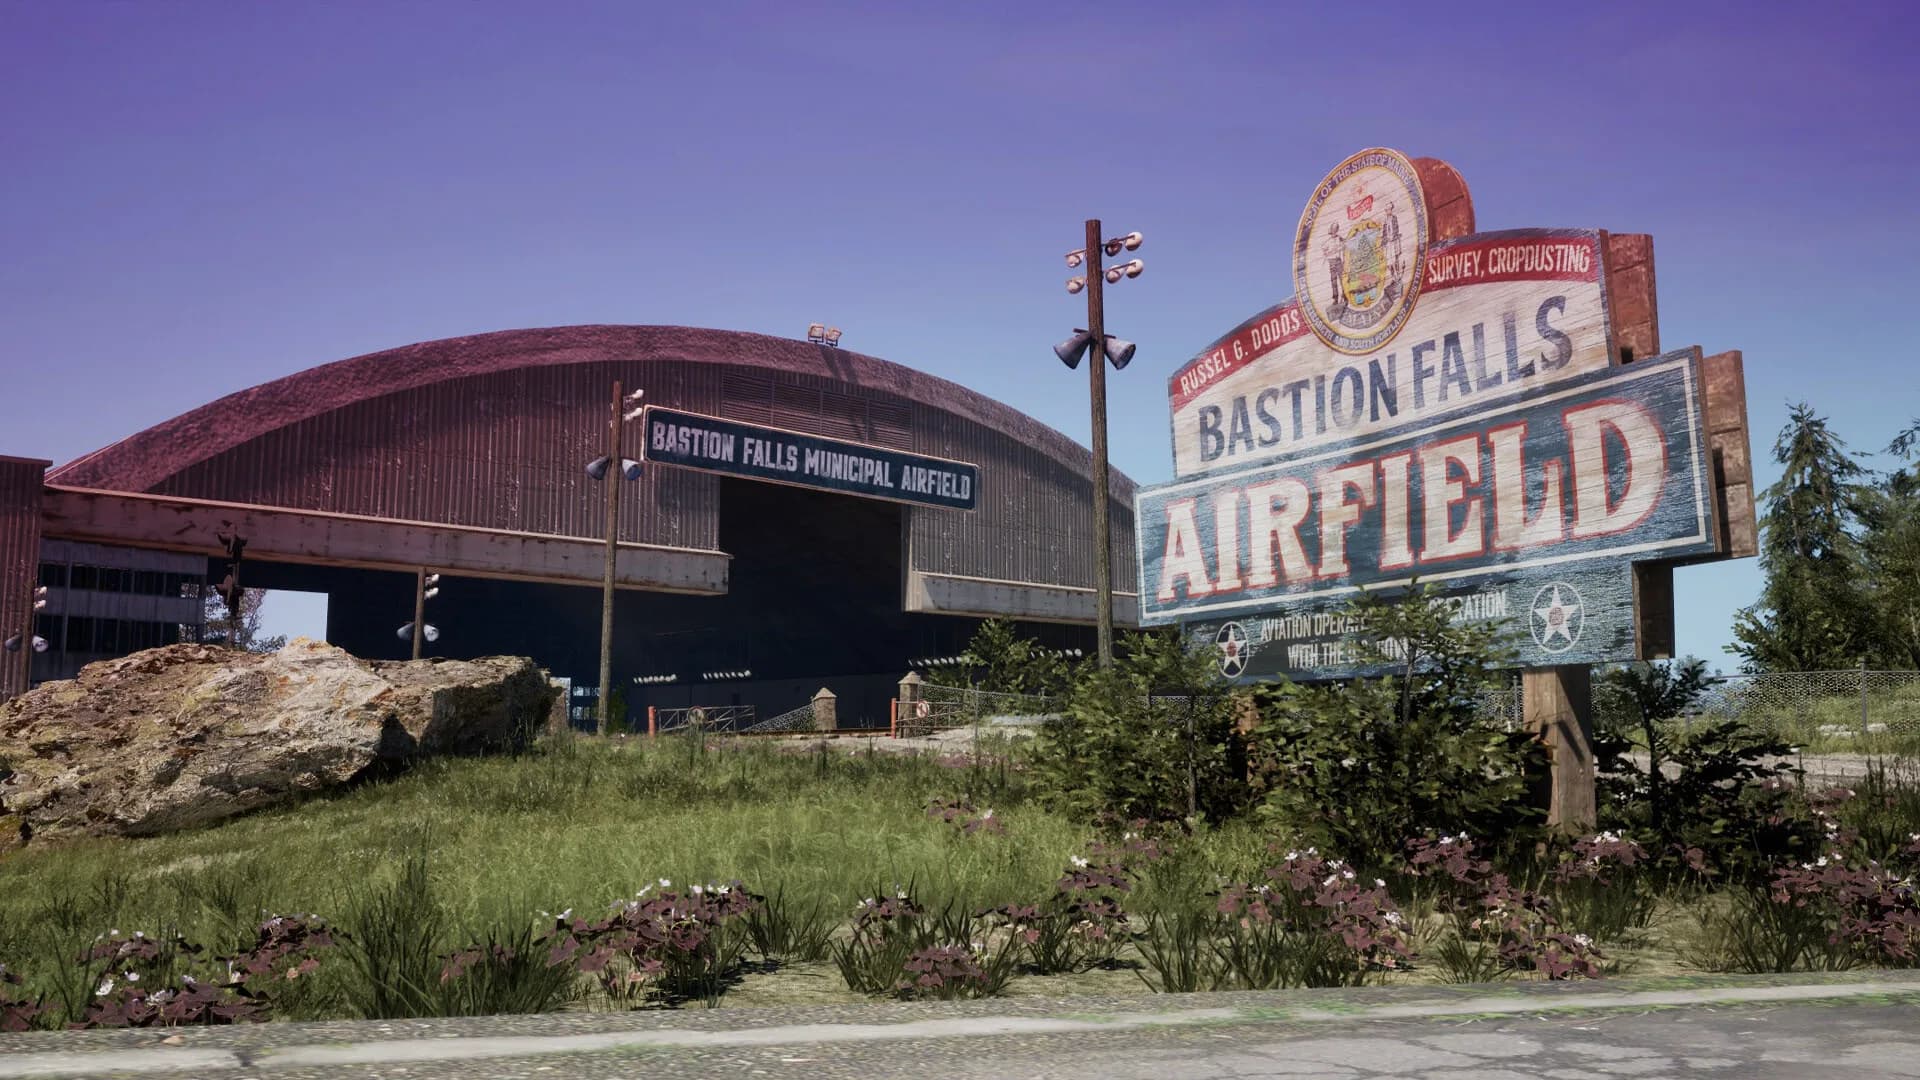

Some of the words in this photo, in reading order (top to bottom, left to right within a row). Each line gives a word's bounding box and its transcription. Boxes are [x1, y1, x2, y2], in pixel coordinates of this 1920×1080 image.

[1320, 182, 1335, 198] OF
[1335, 167, 1352, 185] THE
[1351, 154, 1377, 172] STATE
[1376, 153, 1389, 167] OF
[1428, 250, 1485, 284] SURVEY,
[1488, 244, 1591, 273] CROPDUSTING
[1180, 348, 1232, 397] RUSSEL
[1232, 339, 1249, 361] G.
[1251, 309, 1301, 351] DODDS
[1199, 353, 1399, 462] BASTION
[1412, 295, 1573, 409] FALLS
[652, 421, 734, 463] BASTION
[742, 437, 798, 472] FALLS
[804, 448, 894, 488] MUNICIPAL
[901, 464, 970, 500] AIRFIELD
[1157, 395, 1668, 604] AIRFIELD
[1261, 614, 1311, 641] AVIATION
[1287, 643, 1319, 671] WITH
[1321, 641, 1345, 666] THE
